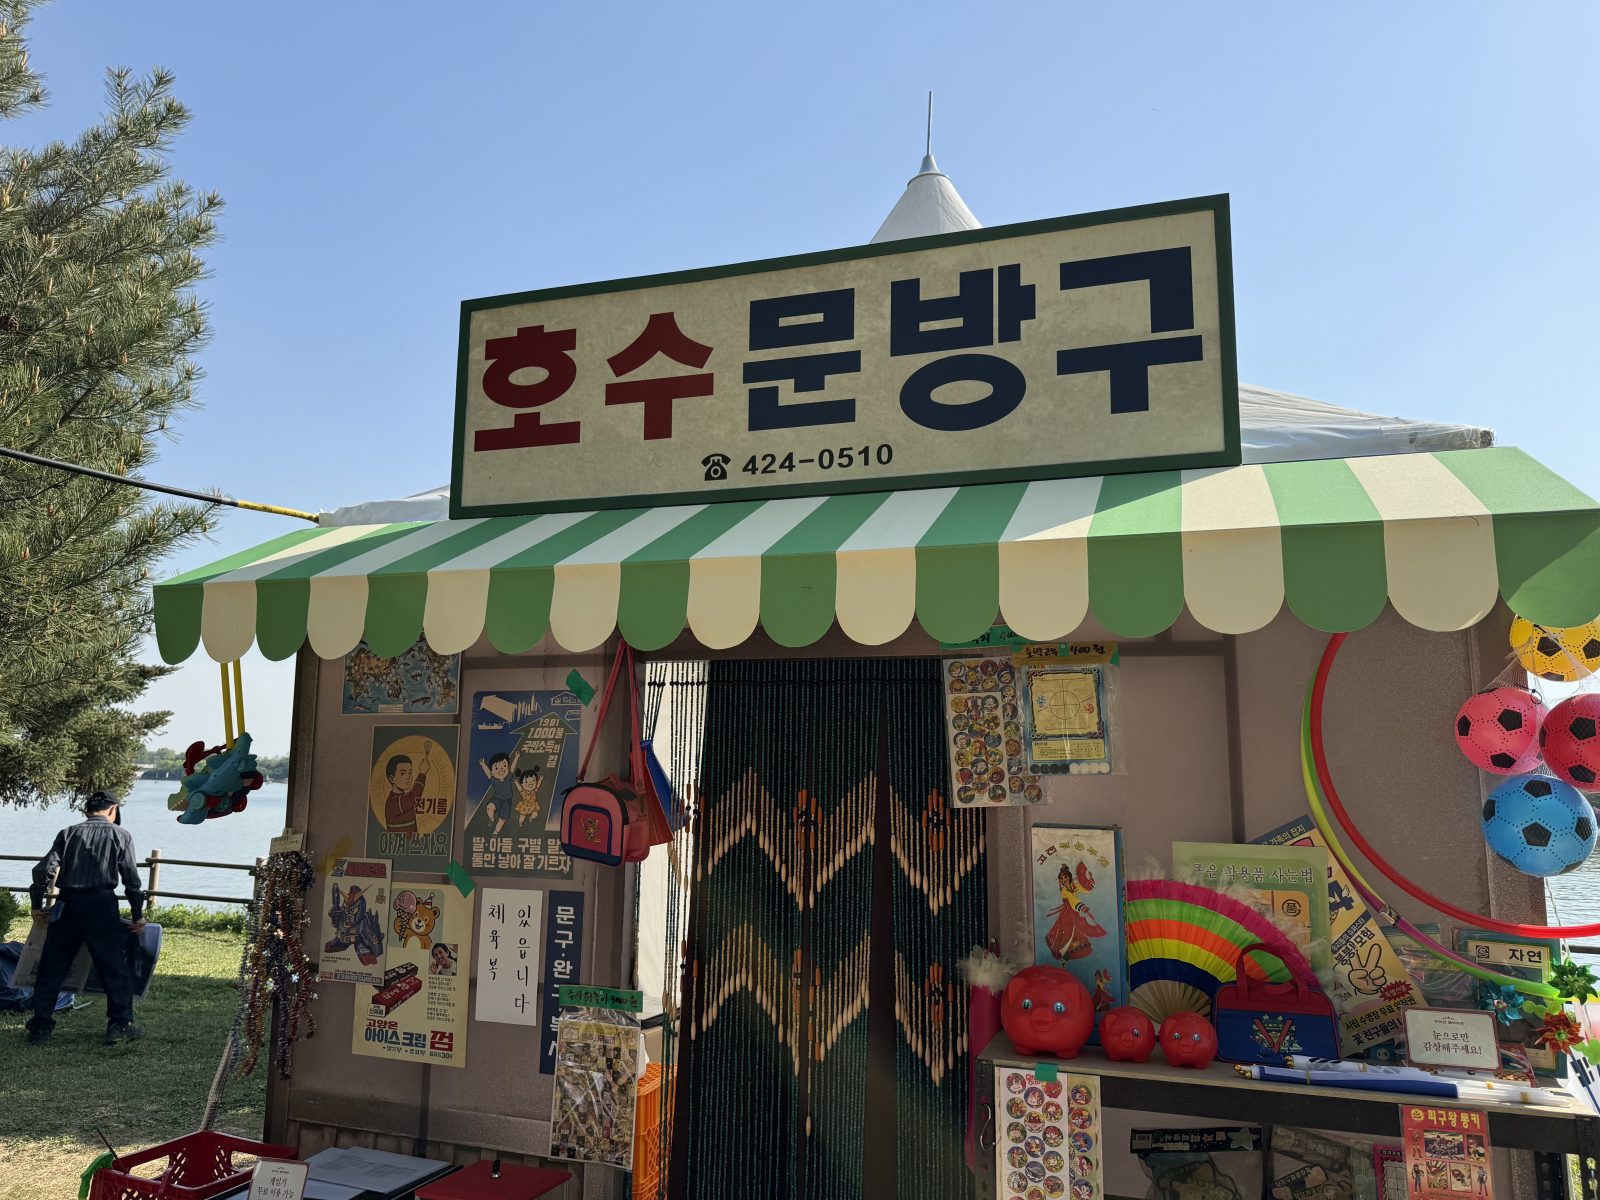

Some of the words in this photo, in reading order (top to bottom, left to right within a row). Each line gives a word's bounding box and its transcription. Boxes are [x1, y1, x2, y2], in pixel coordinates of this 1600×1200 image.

[742, 443, 894, 477] 424-0510
[539, 718, 560, 727] 1981
[521, 740, 561, 754] 국민소득의
[546, 755, 558, 768] 길
[415, 798, 448, 815] 전기를
[1290, 824, 1306, 837] 잡지
[472, 836, 513, 853] 딸·아들
[518, 837, 542, 854] 구별
[547, 838, 566, 855] 말
[472, 852, 496, 868] 둘만
[498, 853, 522, 870] 낳아
[537, 854, 572, 872] 기르자
[1270, 867, 1314, 884] 사는법
[488, 902, 505, 981] 체육복
[1354, 926, 1376, 948] 모험
[514, 904, 532, 1015] 있읍니다
[1508, 948, 1542, 964] 자연
[1345, 1018, 1360, 1031] 시립
[1359, 1010, 1381, 1025] 수영장
[1379, 1004, 1396, 1017] 무료
[429, 1030, 454, 1052] 껌
[1351, 1033, 1365, 1046] 꽃
[1364, 1018, 1399, 1041] 친구들의
[1432, 1030, 1470, 1043] 눈으로만
[1427, 1109, 1457, 1128] 피구왕
[1460, 1112, 1481, 1130] 통키
[257, 1186, 269, 1196] 무료
[283, 1188, 295, 1199] 가능
